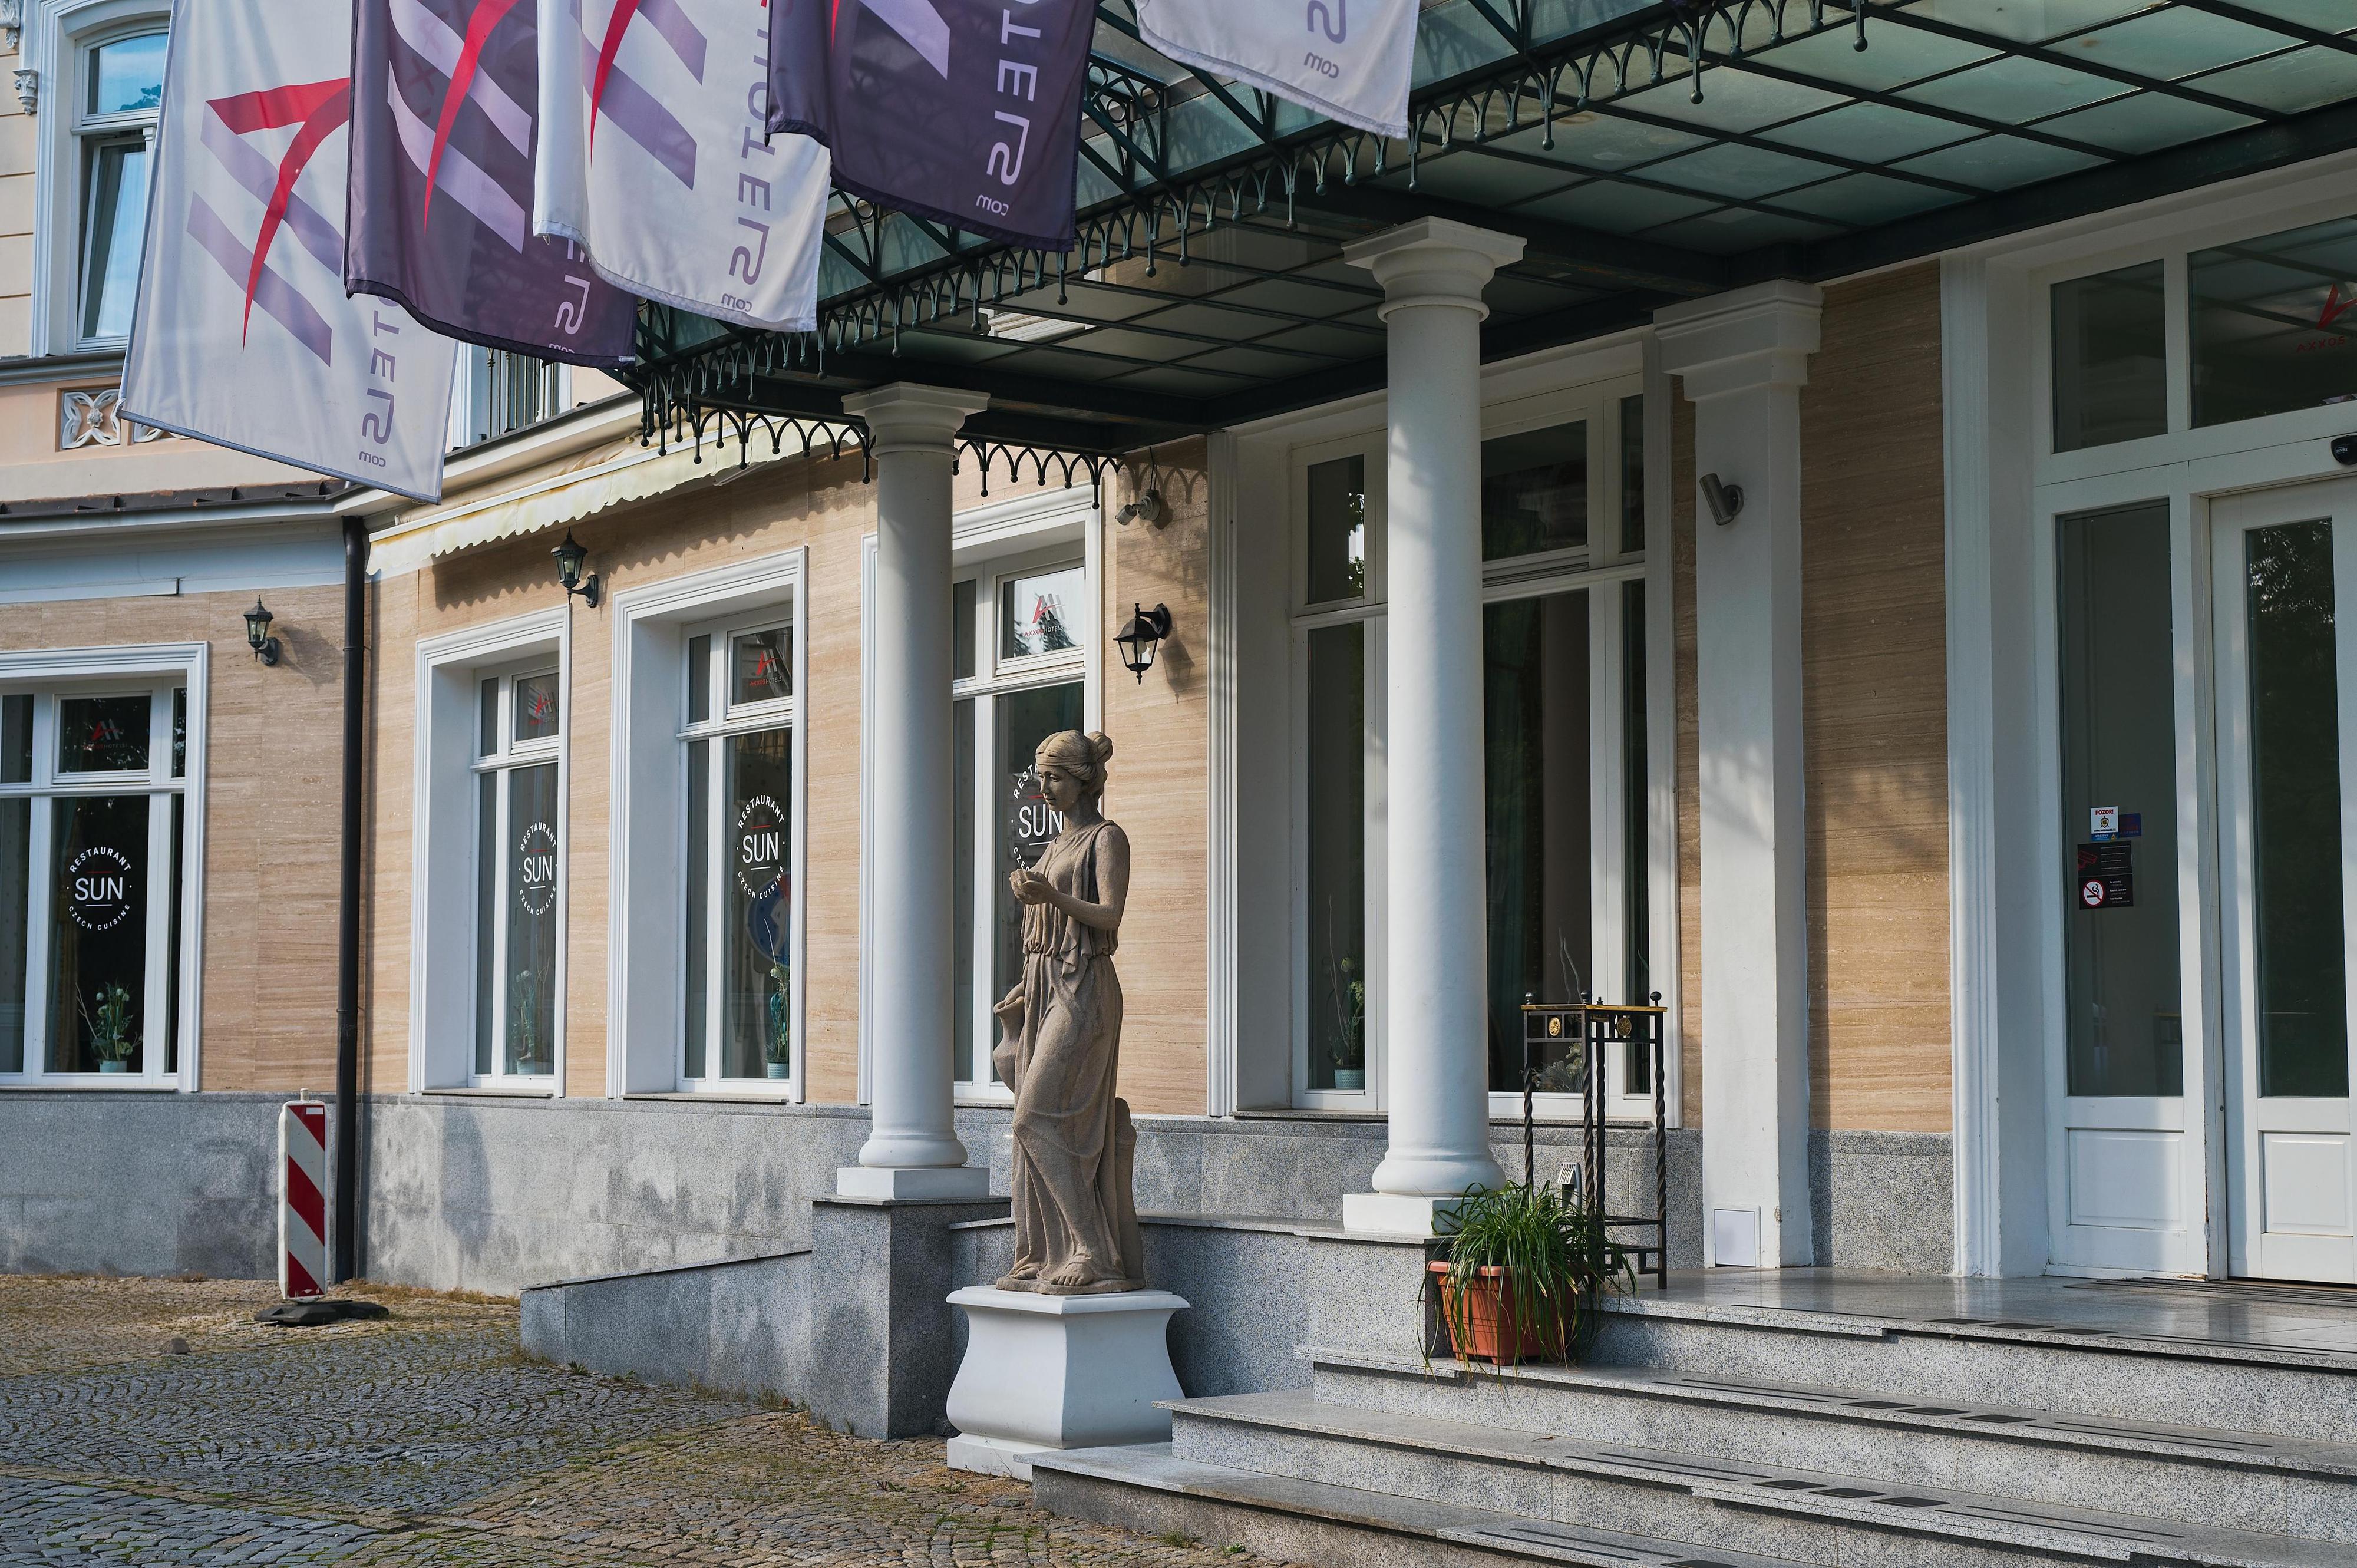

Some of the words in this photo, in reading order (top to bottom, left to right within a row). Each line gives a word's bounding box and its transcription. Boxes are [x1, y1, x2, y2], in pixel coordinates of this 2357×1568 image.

[738, 794, 784, 829] RESTAURANT
[1019, 804, 1063, 839] SUN
[520, 821, 557, 852] RESTAURANT
[742, 831, 778, 864] SUN
[70, 846, 131, 873] RESTAURANT
[523, 855, 552, 883] SUN
[74, 877, 123, 901] SUN
[738, 871, 756, 899] CZECH
[760, 866, 784, 900] CUISINE
[519, 889, 534, 915] CZECH
[536, 886, 556, 916] CUISINE
[68, 906, 93, 929] CZECH
[97, 904, 130, 930] CUISINE
